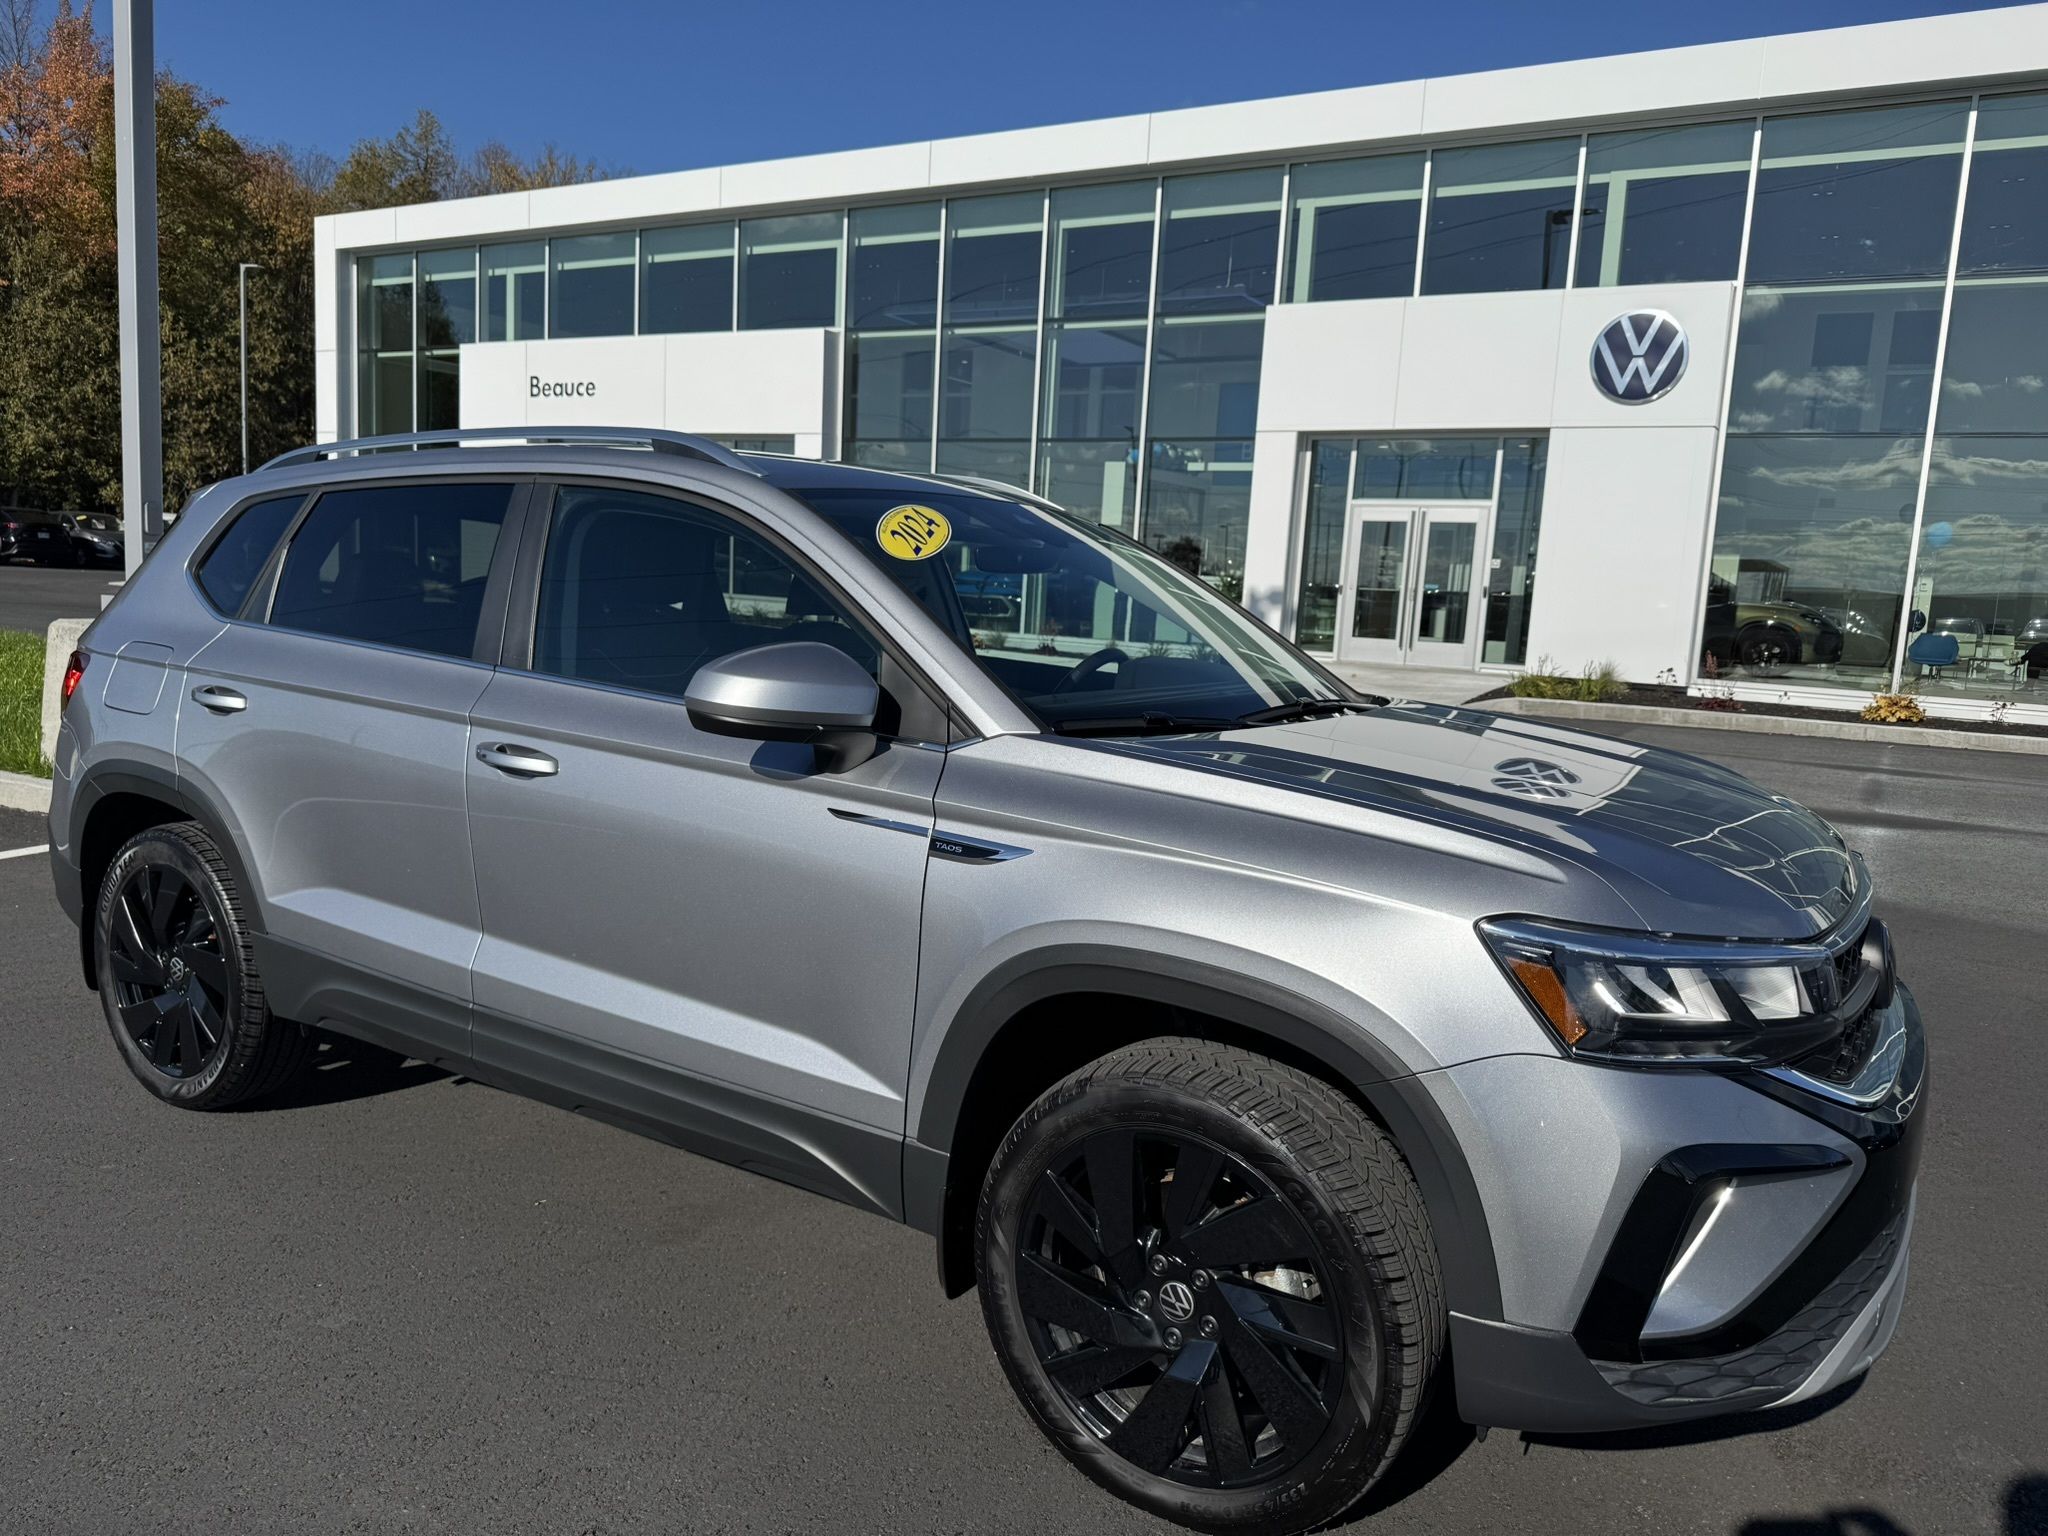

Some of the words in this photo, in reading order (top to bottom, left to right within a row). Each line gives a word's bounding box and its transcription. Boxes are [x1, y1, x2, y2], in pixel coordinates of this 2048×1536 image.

[1592, 311, 1688, 400] VW
[530, 376, 596, 397] Beauce
[890, 507, 940, 556] 2024
[935, 841, 962, 853] TAOS
[1160, 1283, 1193, 1321] VW
